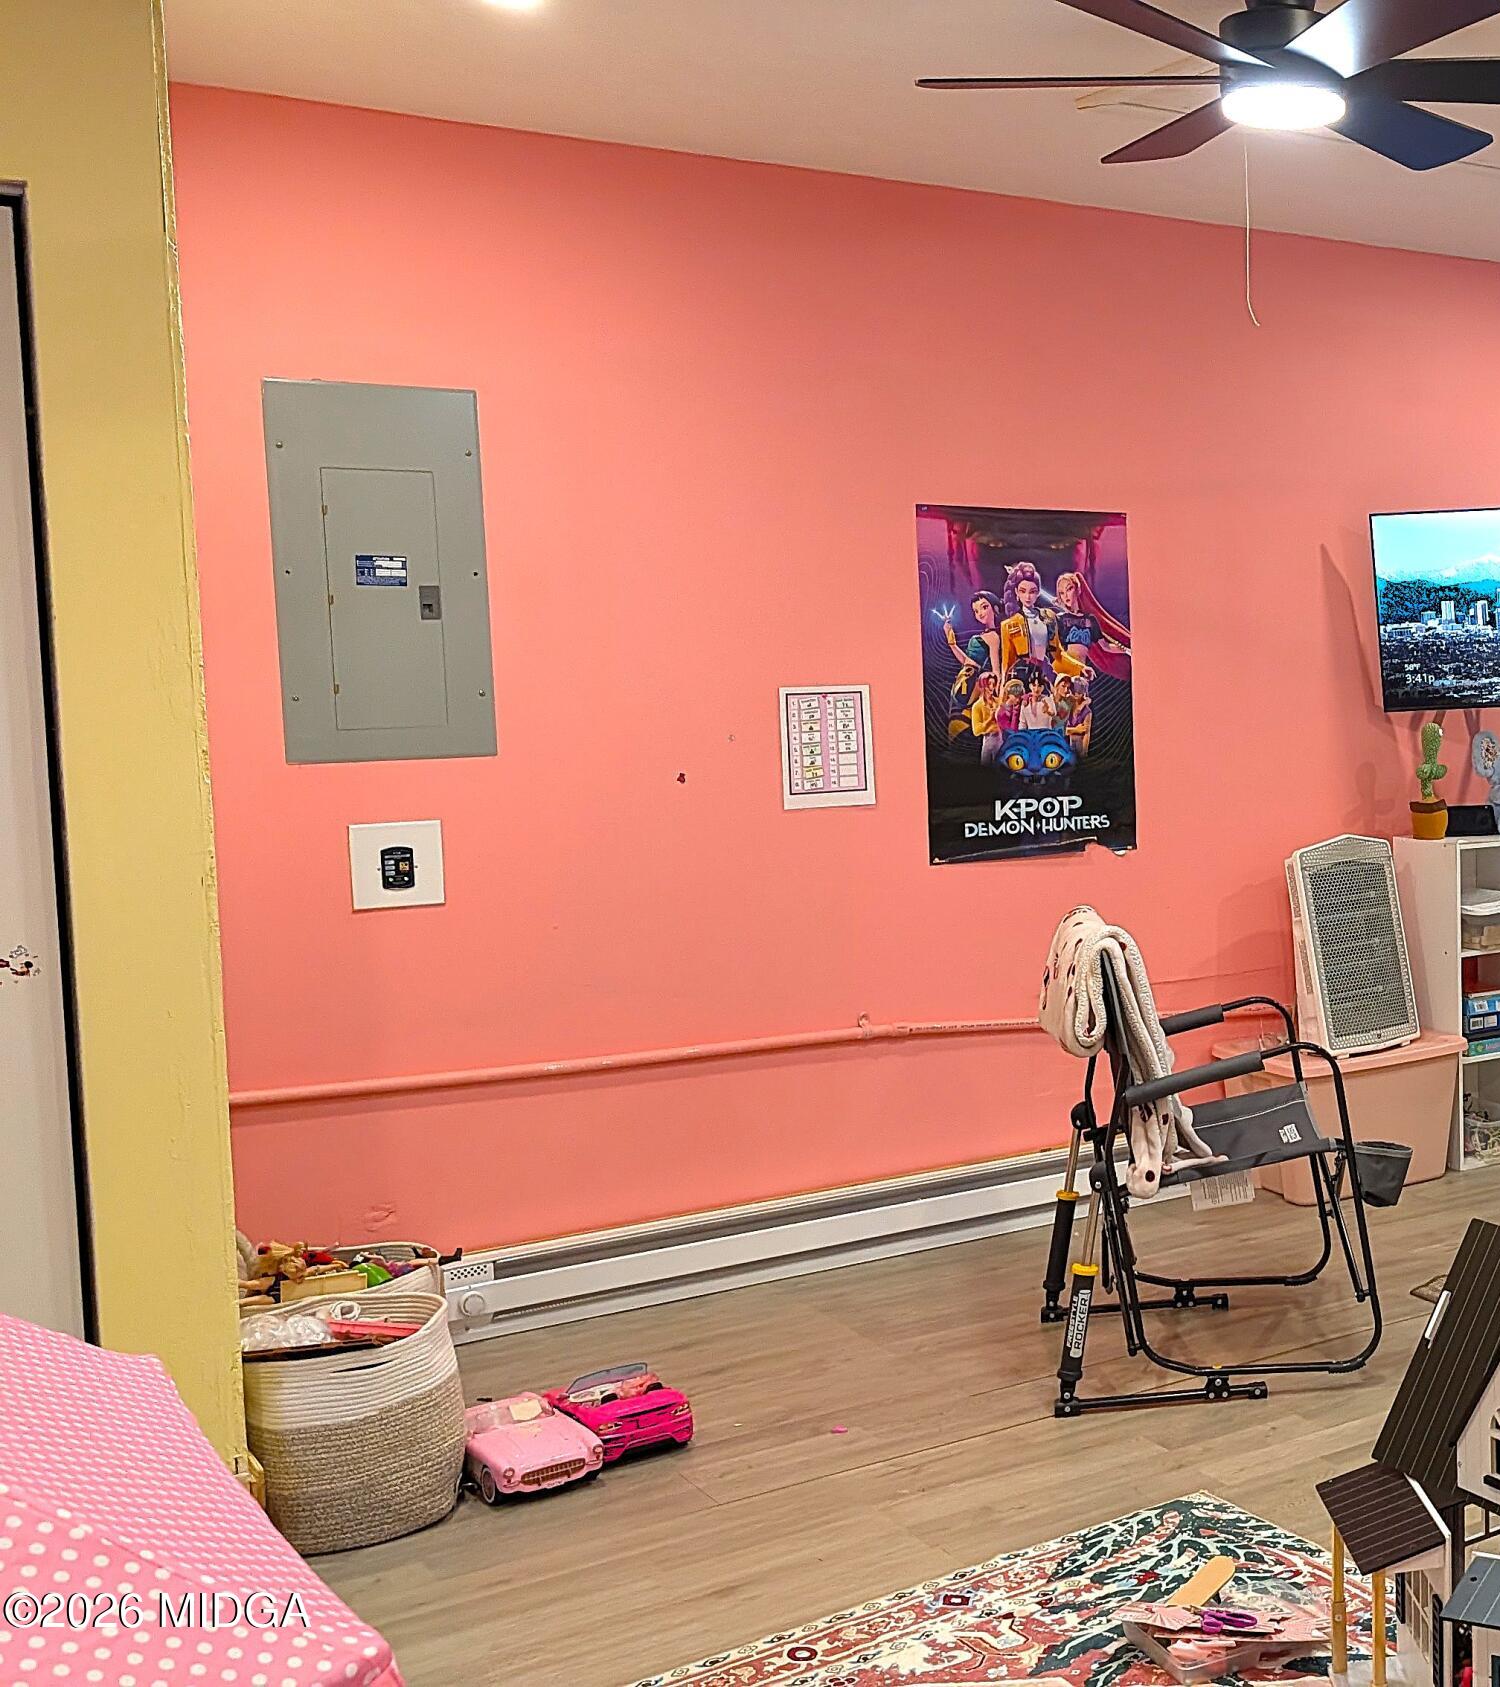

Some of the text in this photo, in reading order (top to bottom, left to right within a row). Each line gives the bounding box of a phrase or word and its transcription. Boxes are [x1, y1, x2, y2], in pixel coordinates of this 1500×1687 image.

[1405, 673, 1435, 684] 3:41p
[964, 814, 1111, 838] DEMON HUNTERS
[1066, 1294, 1079, 1348] FREESTYLE
[1073, 1297, 1090, 1350] ROCKER
